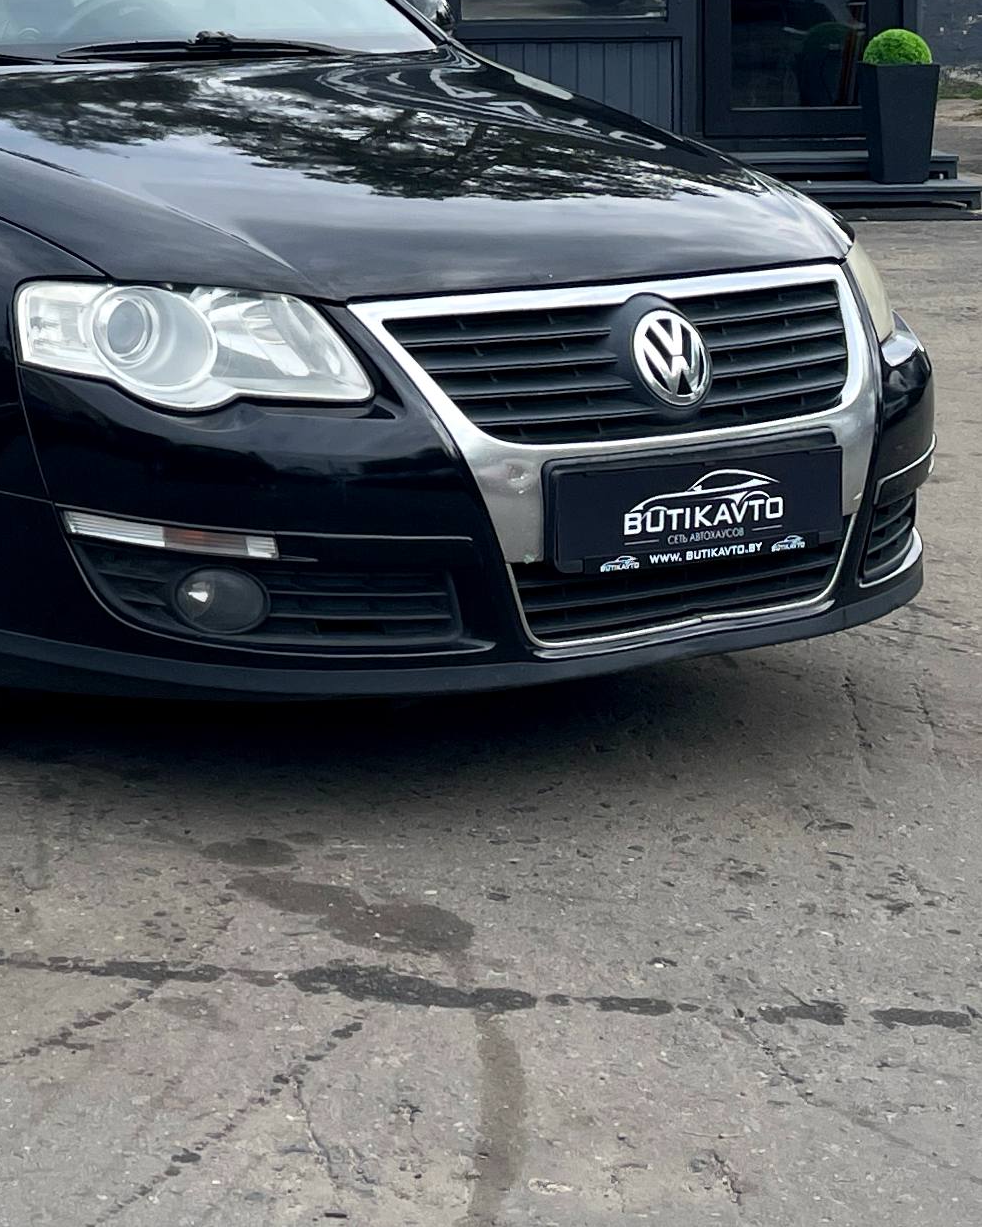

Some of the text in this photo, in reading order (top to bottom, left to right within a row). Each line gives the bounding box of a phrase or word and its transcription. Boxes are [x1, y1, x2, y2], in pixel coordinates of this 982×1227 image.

[623, 496, 784, 536] BUTIKAVTO
[667, 527, 745, 545] СЕТЬ АВТОХАУСОВ
[649, 542, 763, 564] WWW. BUTIKAVTO.BY
